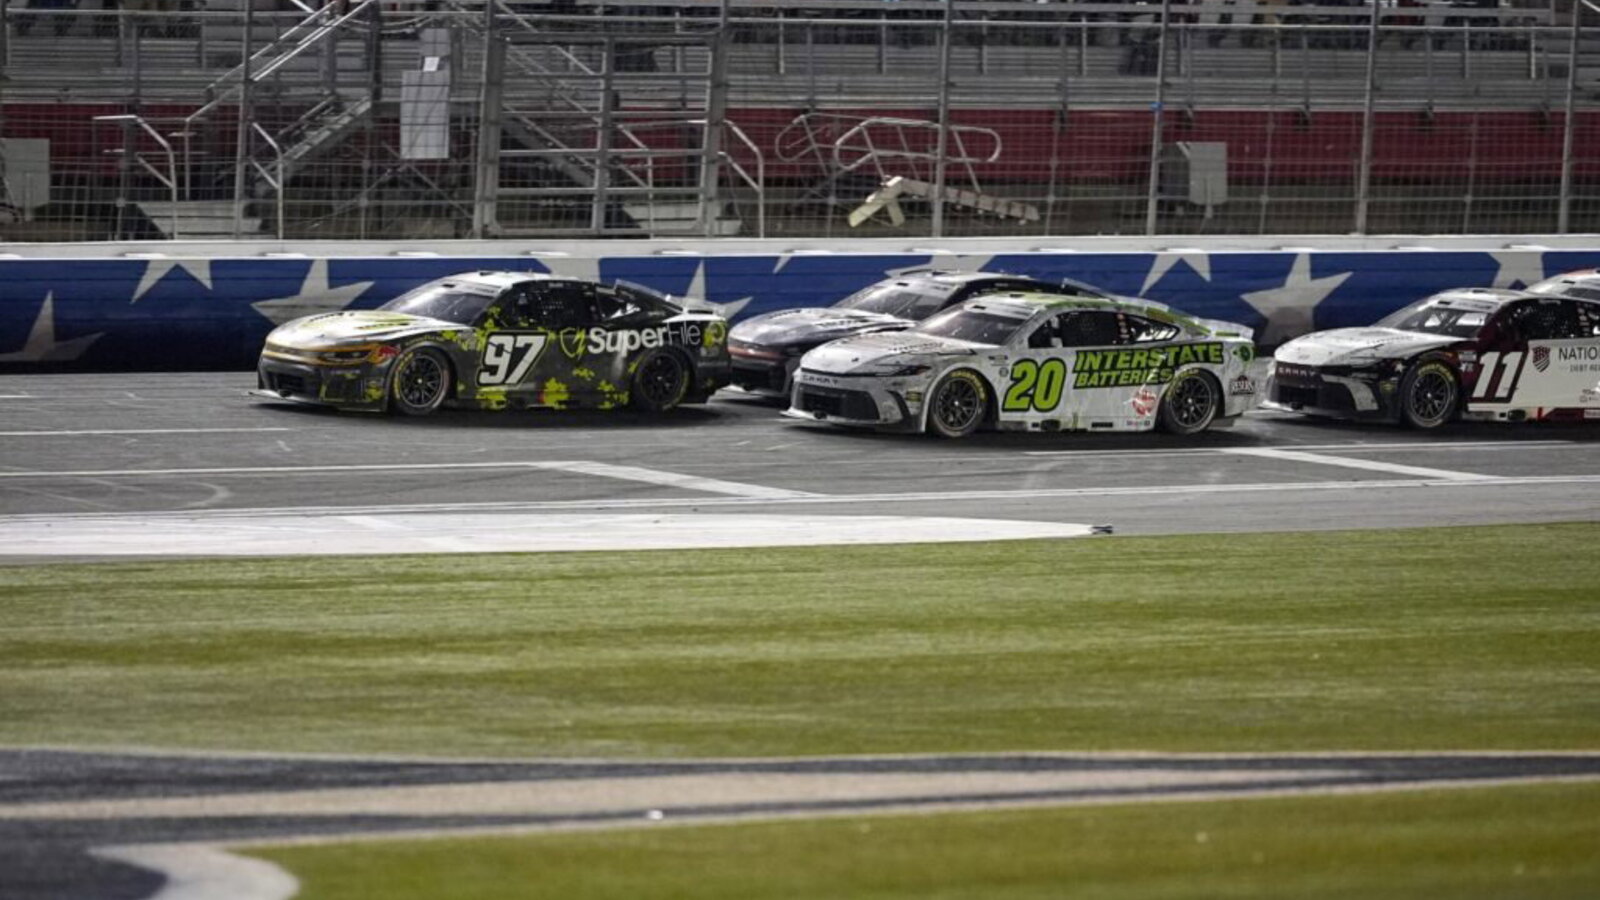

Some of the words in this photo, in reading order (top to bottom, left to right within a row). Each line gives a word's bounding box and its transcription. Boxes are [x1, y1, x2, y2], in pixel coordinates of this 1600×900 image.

[587, 320, 701, 358] SuperFile
[1075, 343, 1223, 371] INTERSTATE
[1559, 346, 1600, 360] NATIO
[477, 334, 547, 387] 97
[1076, 369, 1174, 387] BATTERIES
[1472, 351, 1523, 398] 11
[1002, 358, 1067, 411] 20
